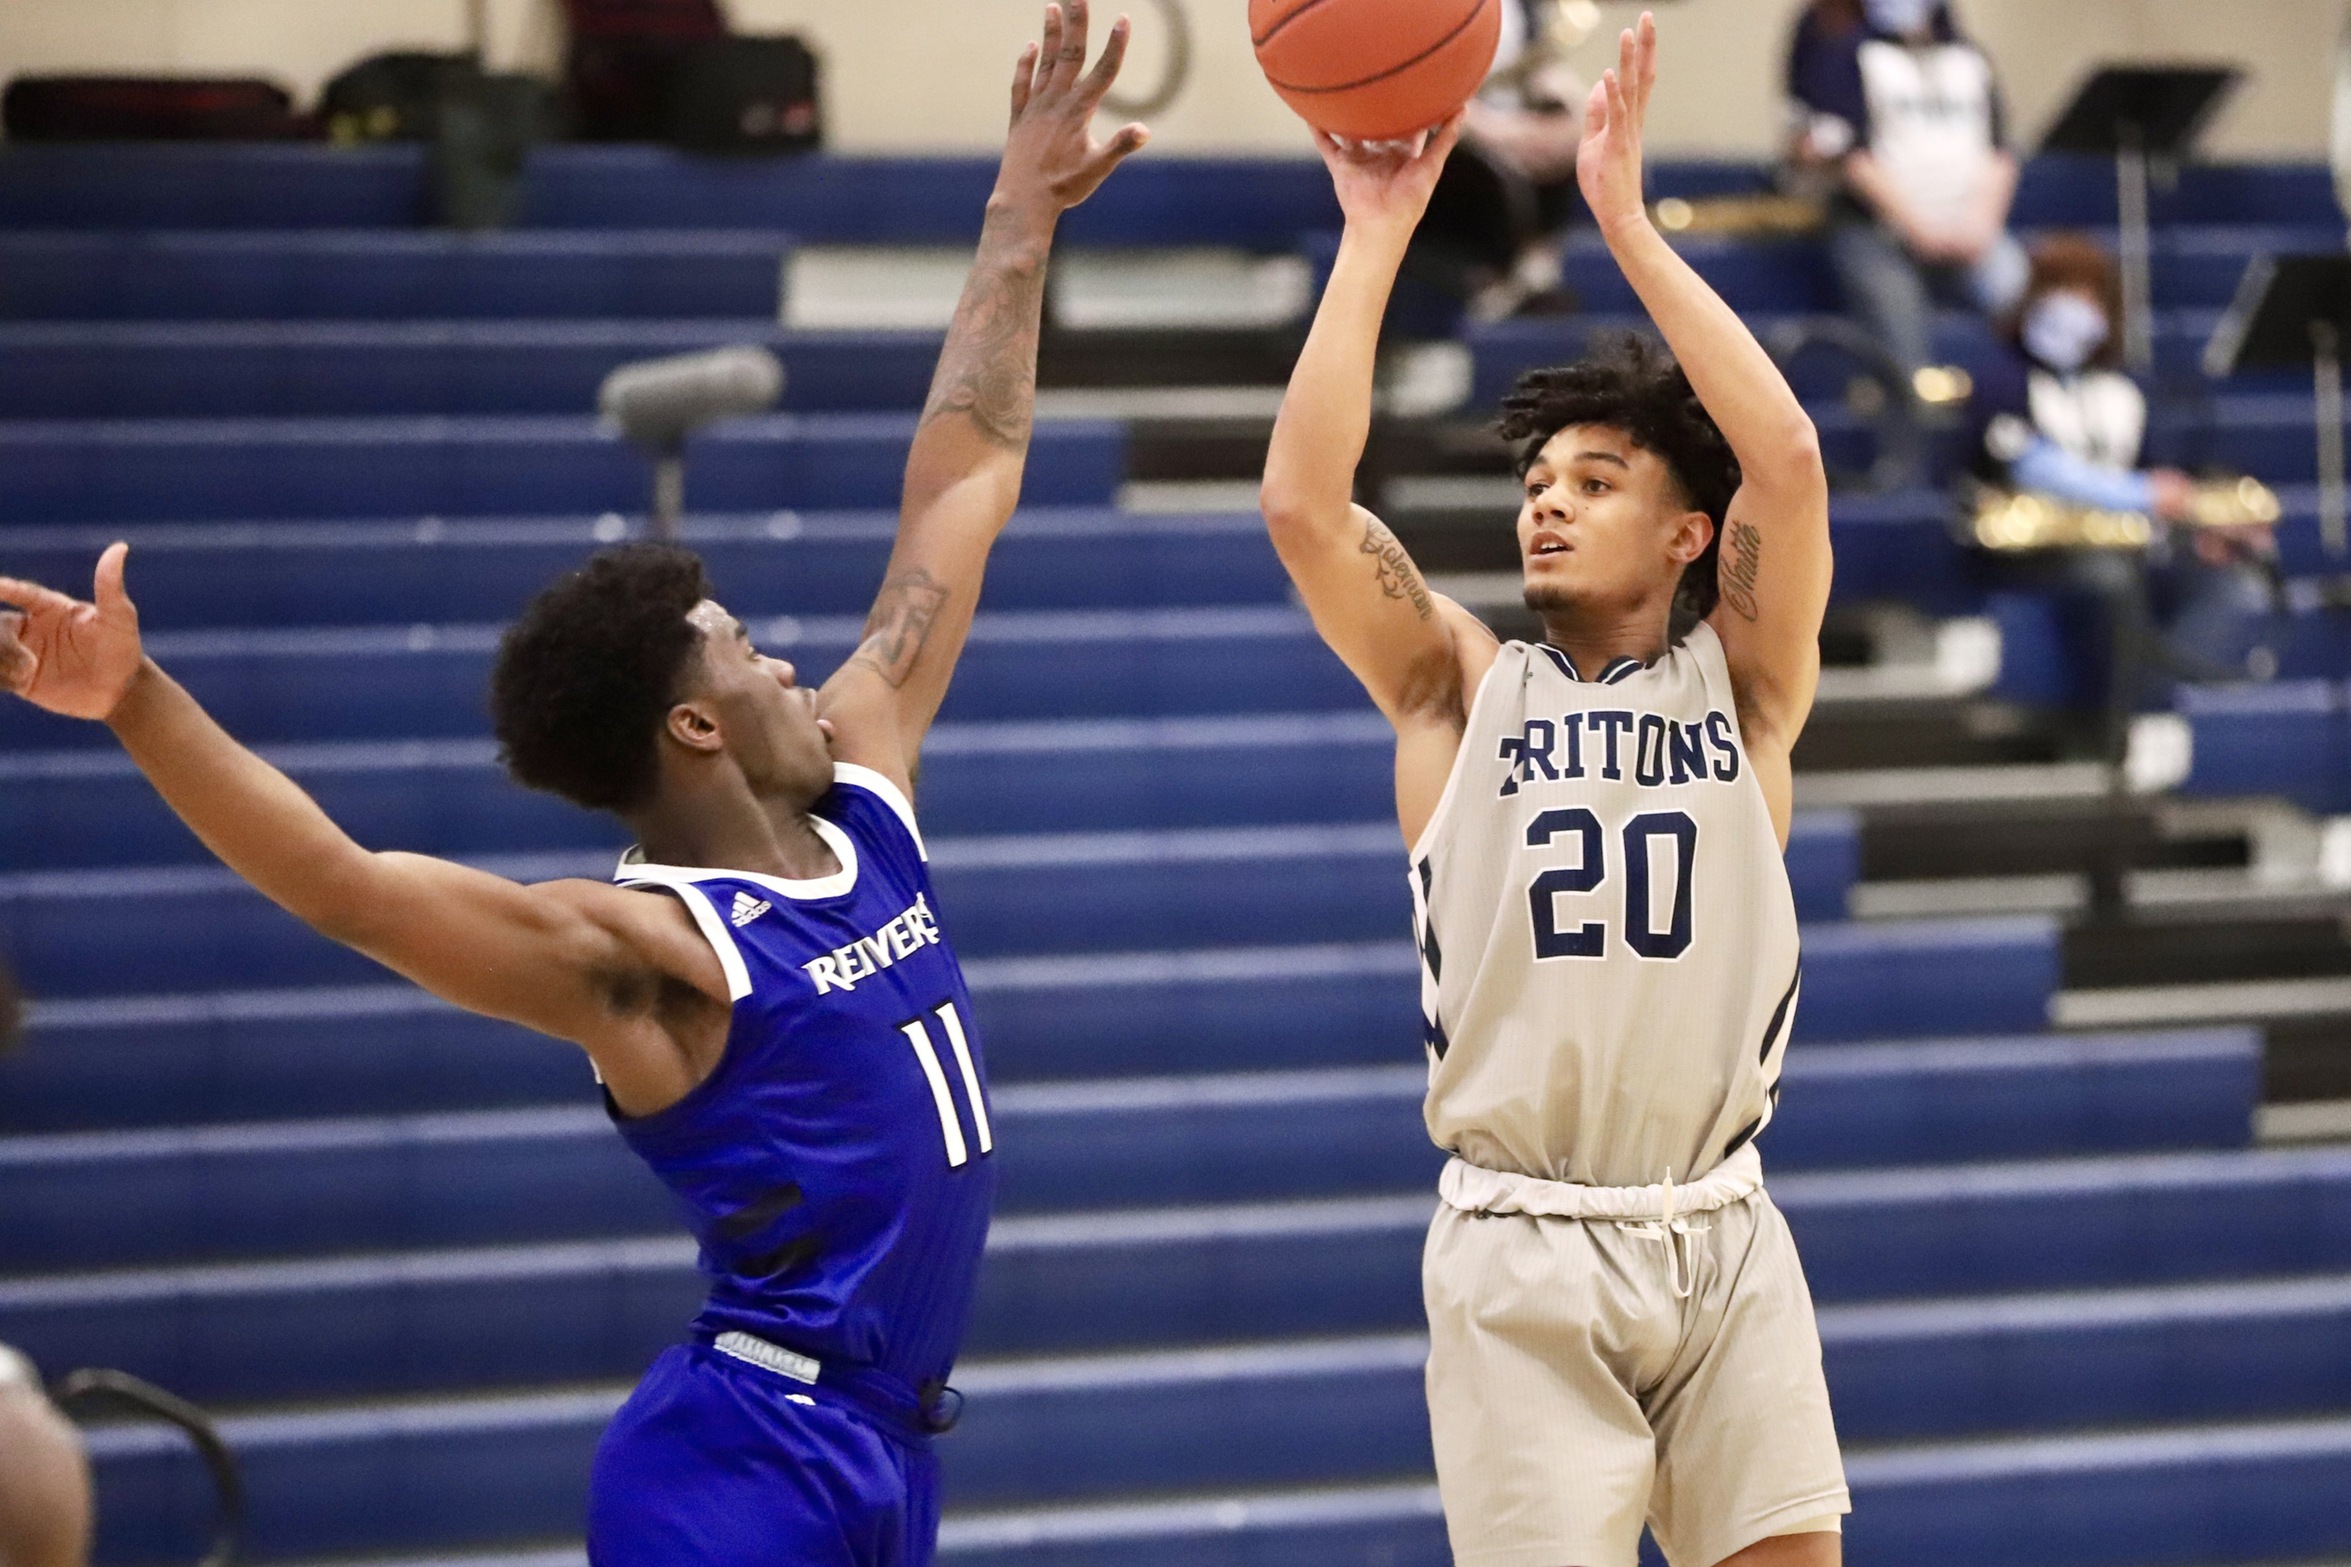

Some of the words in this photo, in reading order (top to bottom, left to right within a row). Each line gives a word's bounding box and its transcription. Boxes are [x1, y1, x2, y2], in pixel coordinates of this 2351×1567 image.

[1495, 709, 1740, 799] TRITONS
[1523, 806, 1700, 962] 20
[899, 1001, 993, 1168] 11
